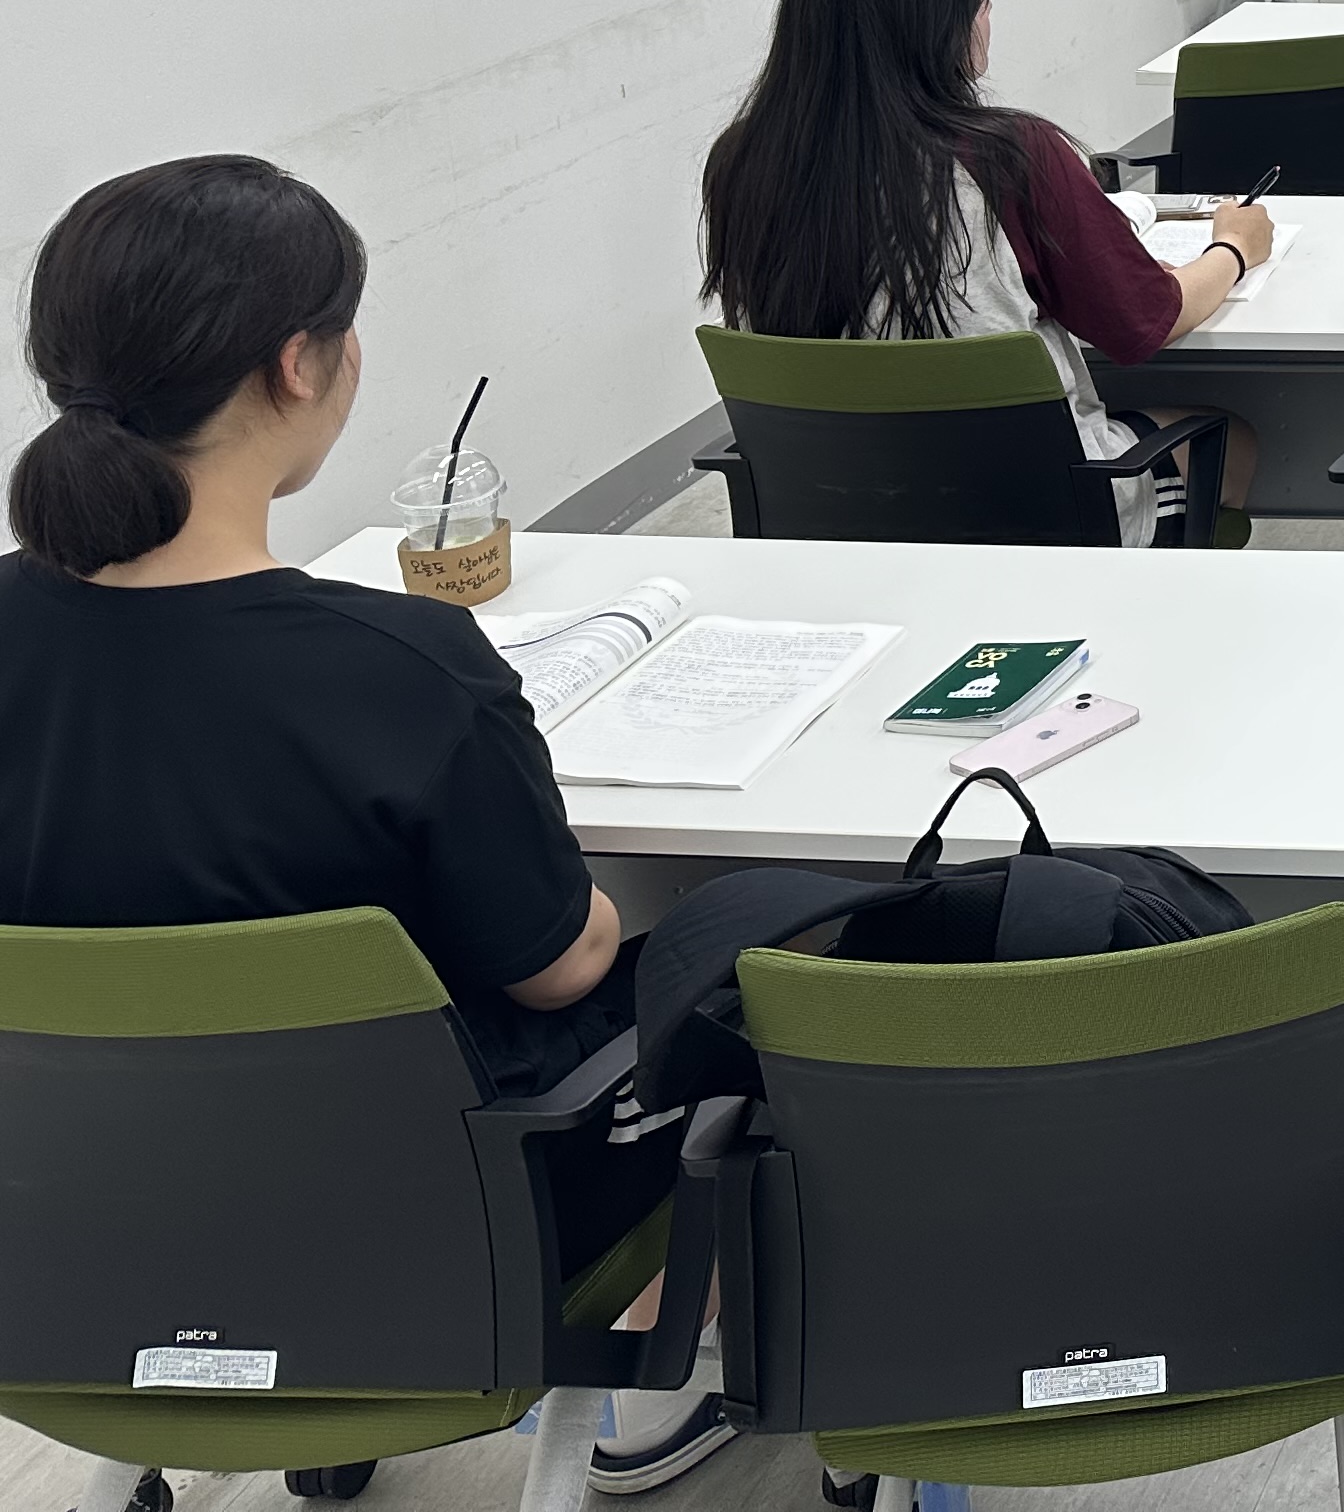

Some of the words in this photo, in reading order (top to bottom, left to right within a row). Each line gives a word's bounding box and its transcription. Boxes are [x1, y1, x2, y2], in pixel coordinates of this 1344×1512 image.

[410, 559, 447, 577] 오늘도
[176, 1328, 218, 1343] patra
[1065, 1348, 1108, 1363] patra
